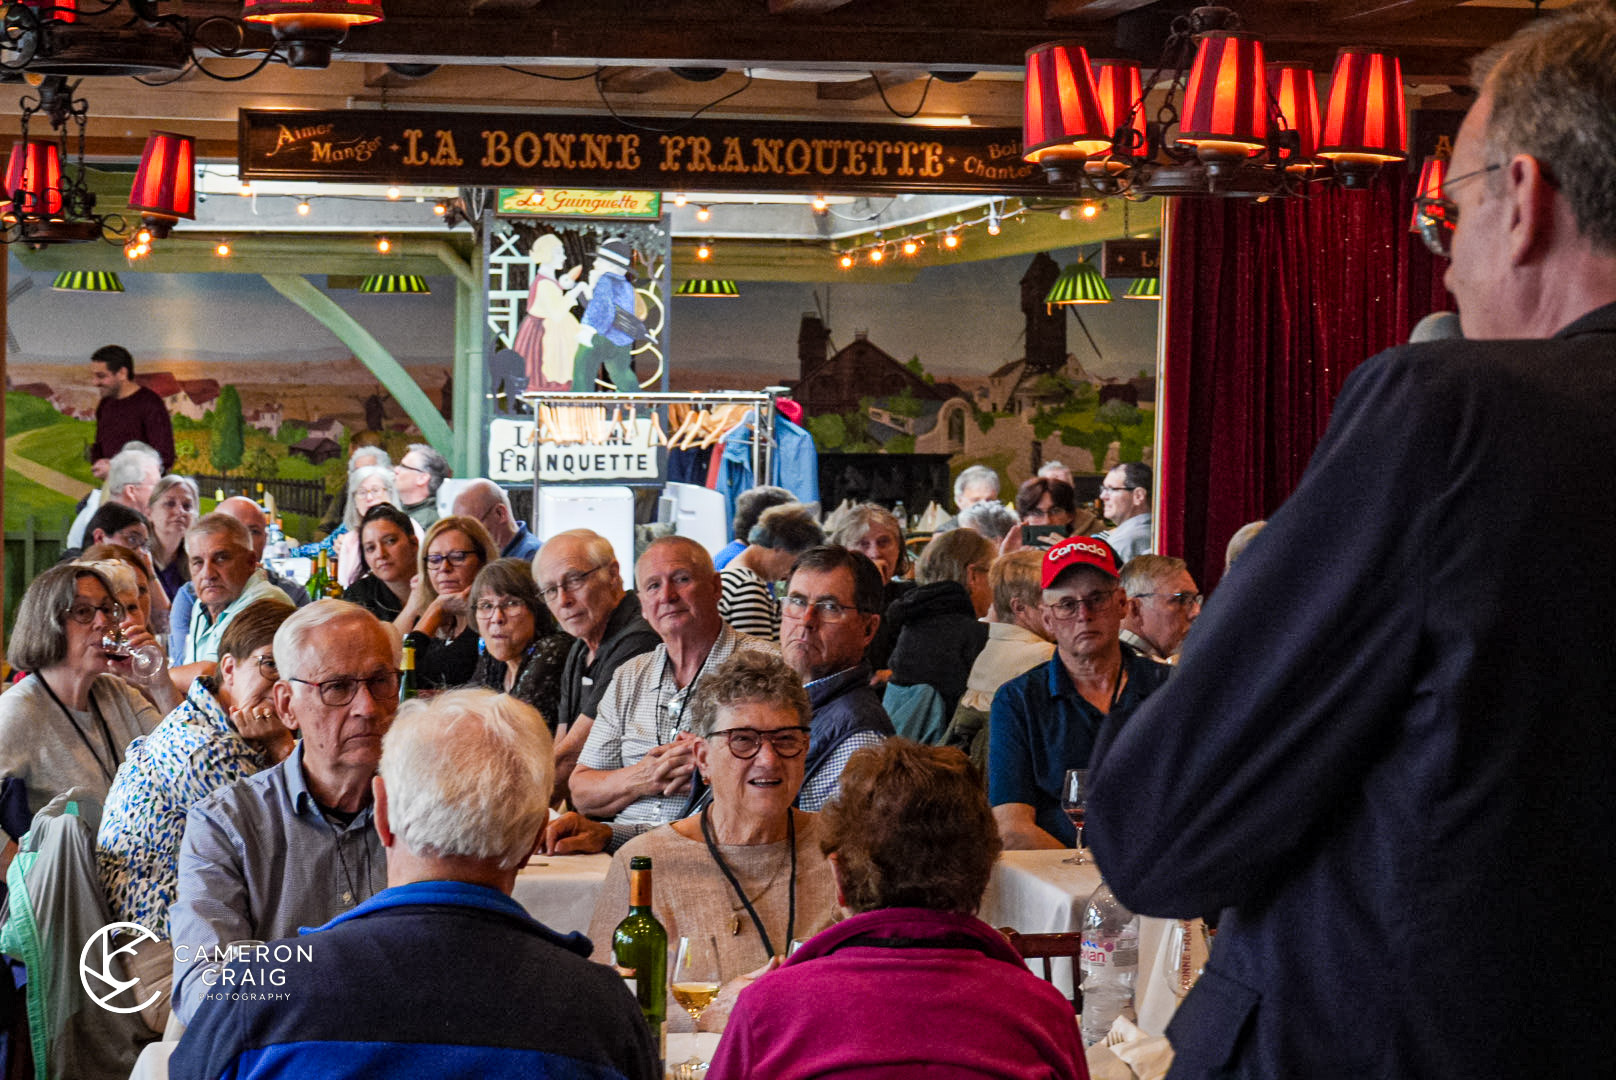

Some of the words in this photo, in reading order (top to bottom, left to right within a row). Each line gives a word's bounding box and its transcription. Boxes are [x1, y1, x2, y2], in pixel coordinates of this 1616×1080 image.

[402, 128, 463, 167] LA
[480, 130, 641, 170] BONNE
[659, 135, 944, 178] FRANQUETTE
[963, 156, 1034, 179] Chanter
[547, 190, 639, 213] Guinguette
[1048, 542, 1107, 561] Canada
